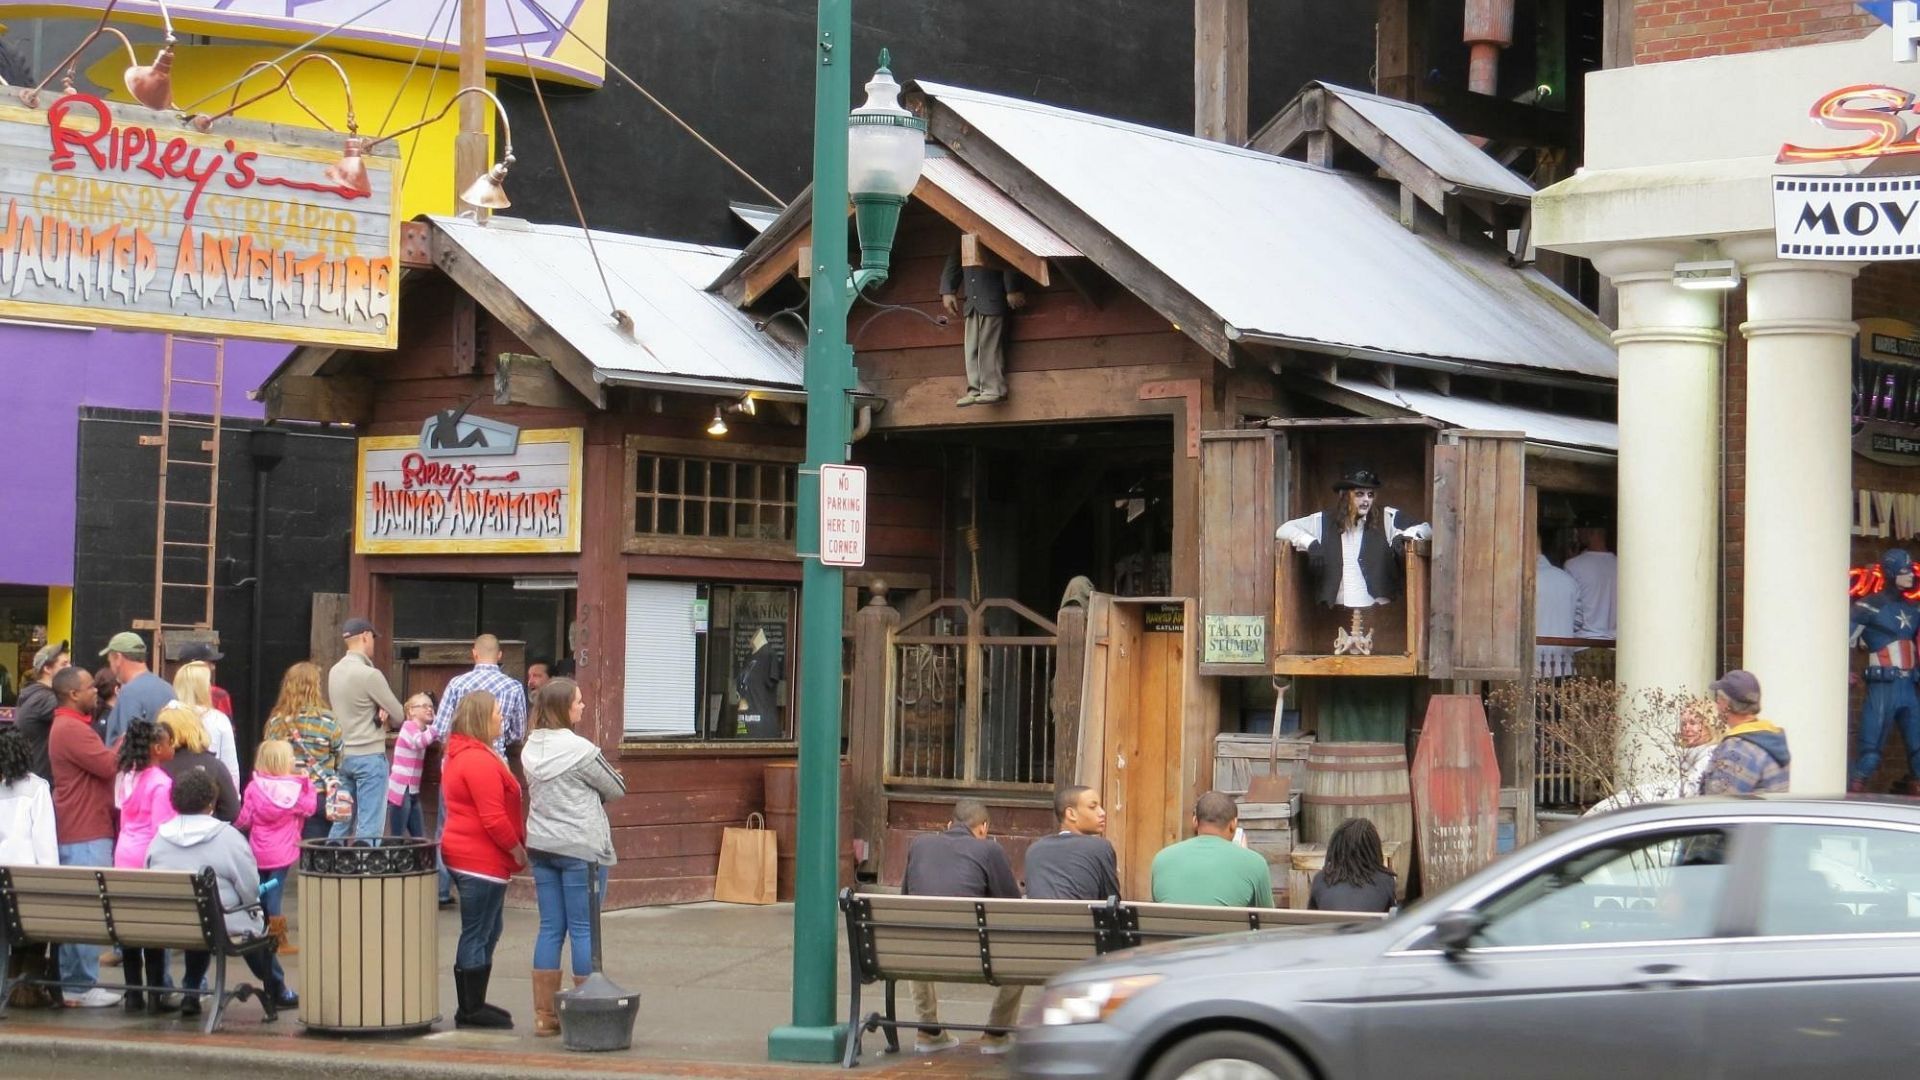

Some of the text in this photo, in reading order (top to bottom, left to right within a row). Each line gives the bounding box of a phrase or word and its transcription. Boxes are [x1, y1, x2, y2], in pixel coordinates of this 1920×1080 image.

[32, 172, 359, 257] GRIMSBY STREAPER
[169, 223, 392, 327] ADVENTURE
[838, 477, 850, 491] NO
[372, 481, 562, 538] HAUNTED ADVENTURE
[827, 497, 860, 512] PARKING
[827, 519, 860, 533] HERE TO
[828, 540, 858, 554] CORNER
[1208, 624, 1262, 637] TALK TO
[1210, 638, 1260, 652] STUMPY
